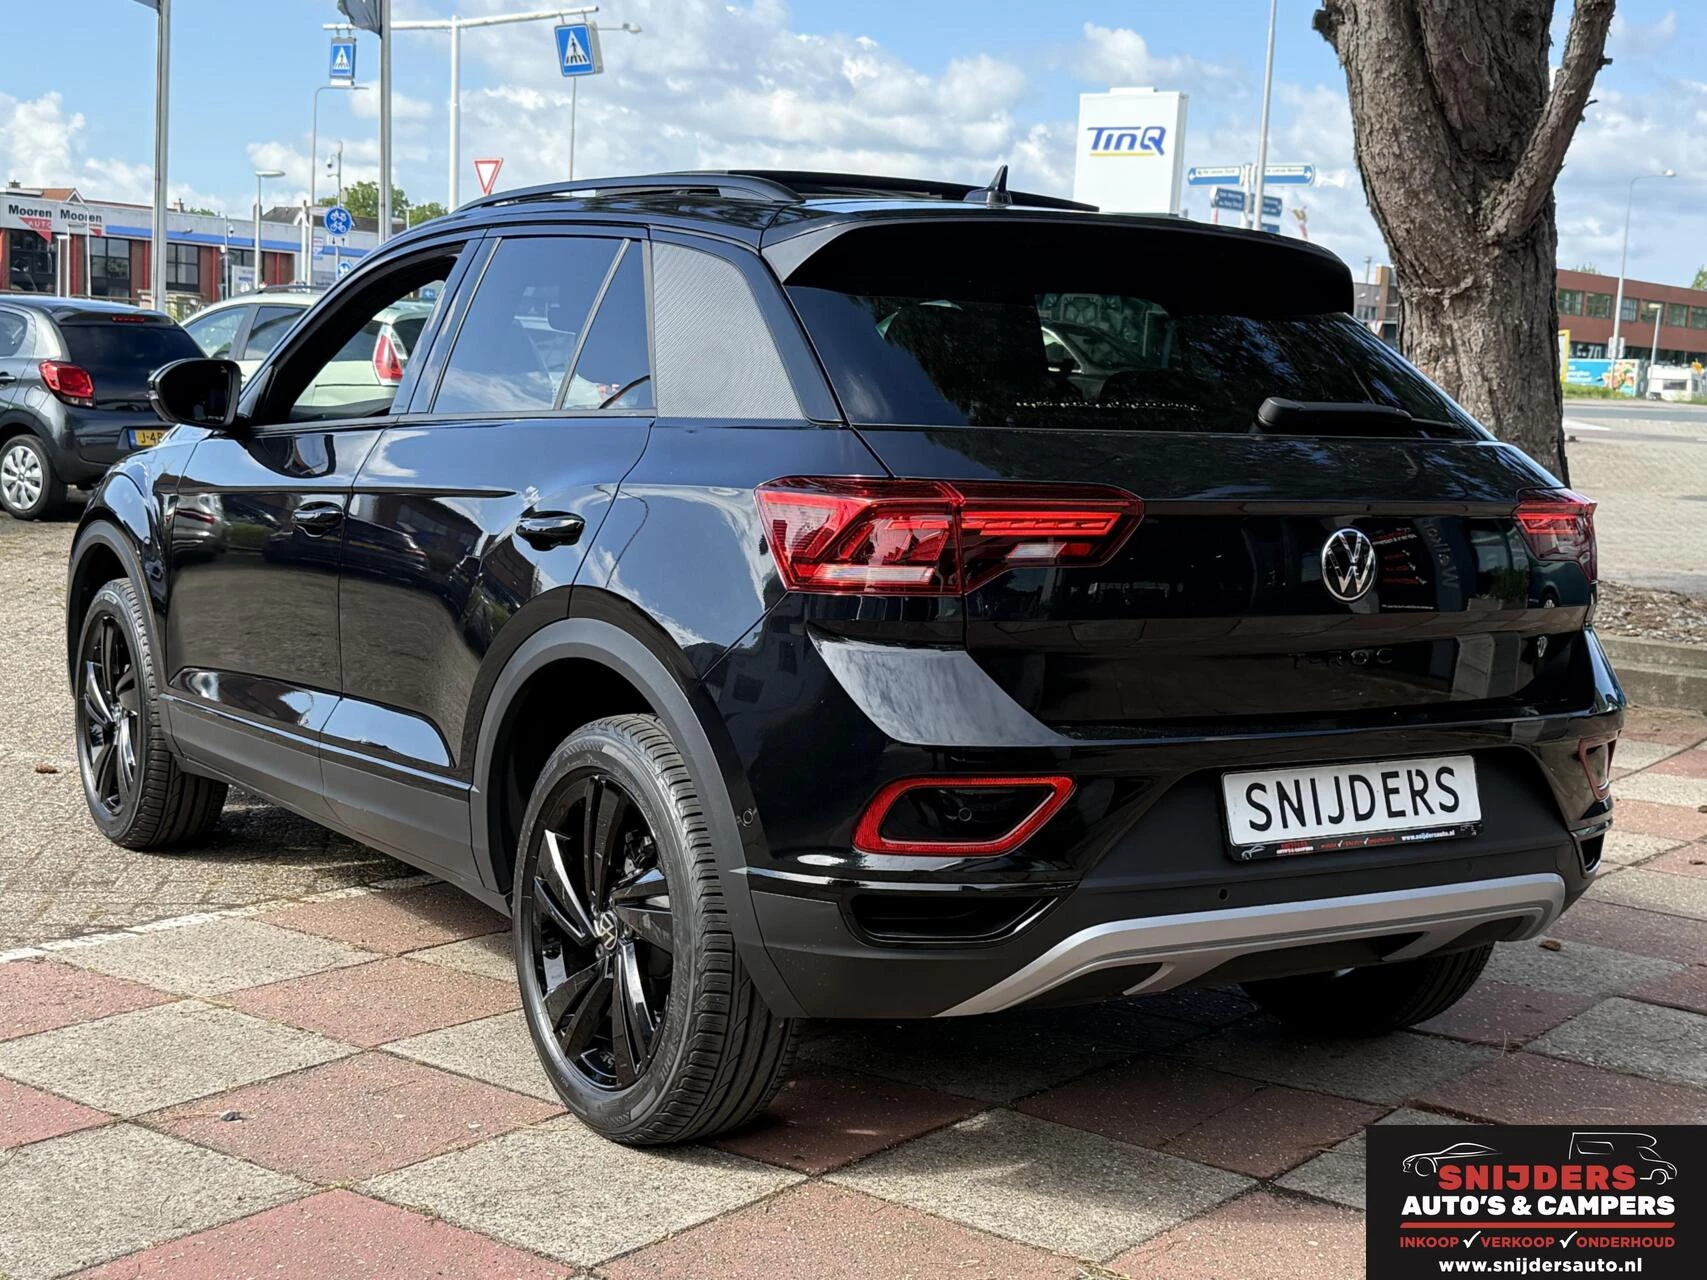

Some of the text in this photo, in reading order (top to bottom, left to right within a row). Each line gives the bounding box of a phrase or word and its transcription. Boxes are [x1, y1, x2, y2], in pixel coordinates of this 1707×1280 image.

[8, 204, 52, 218] Mooren
[60, 209, 102, 222] Mooren
[1245, 766, 1459, 831] SNIJDERS
